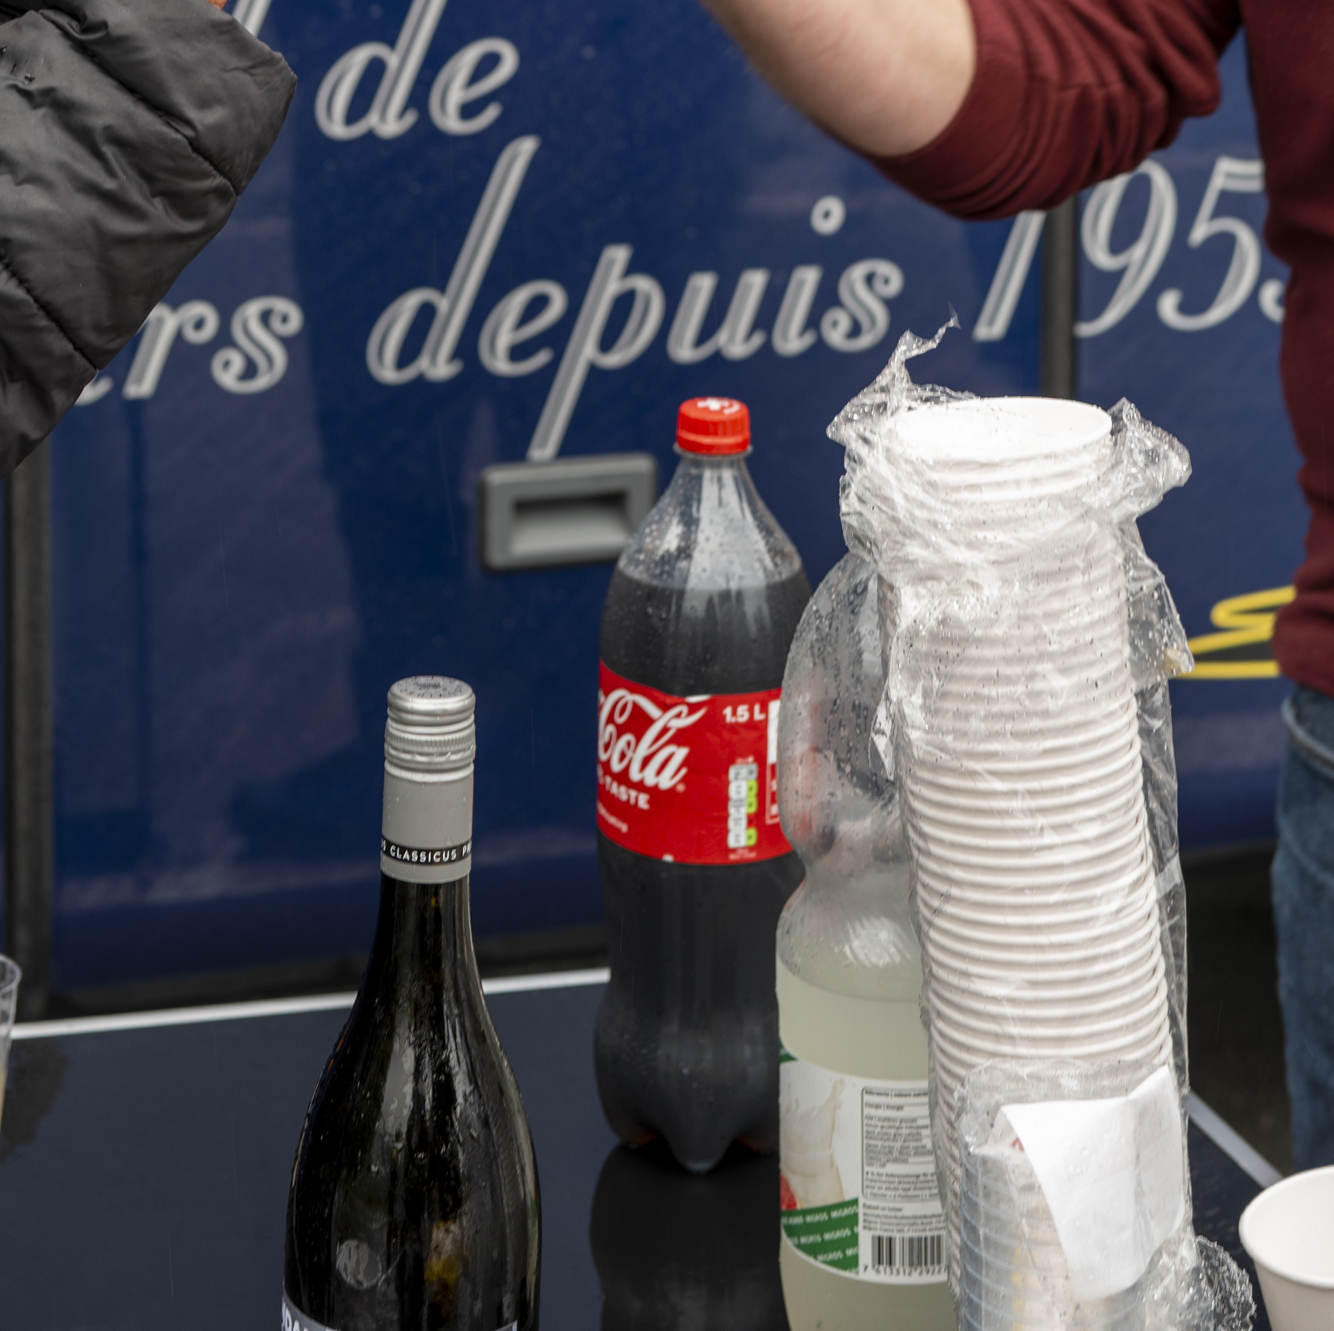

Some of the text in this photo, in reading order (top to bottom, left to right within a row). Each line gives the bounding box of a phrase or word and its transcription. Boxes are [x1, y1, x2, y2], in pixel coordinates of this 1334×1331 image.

[74, 135, 1286, 462] rs depuis 195
[722, 703, 766, 724] 1.5 L
[604, 774, 651, 811] TASTE
[389, 844, 457, 863] CLASSICUS
